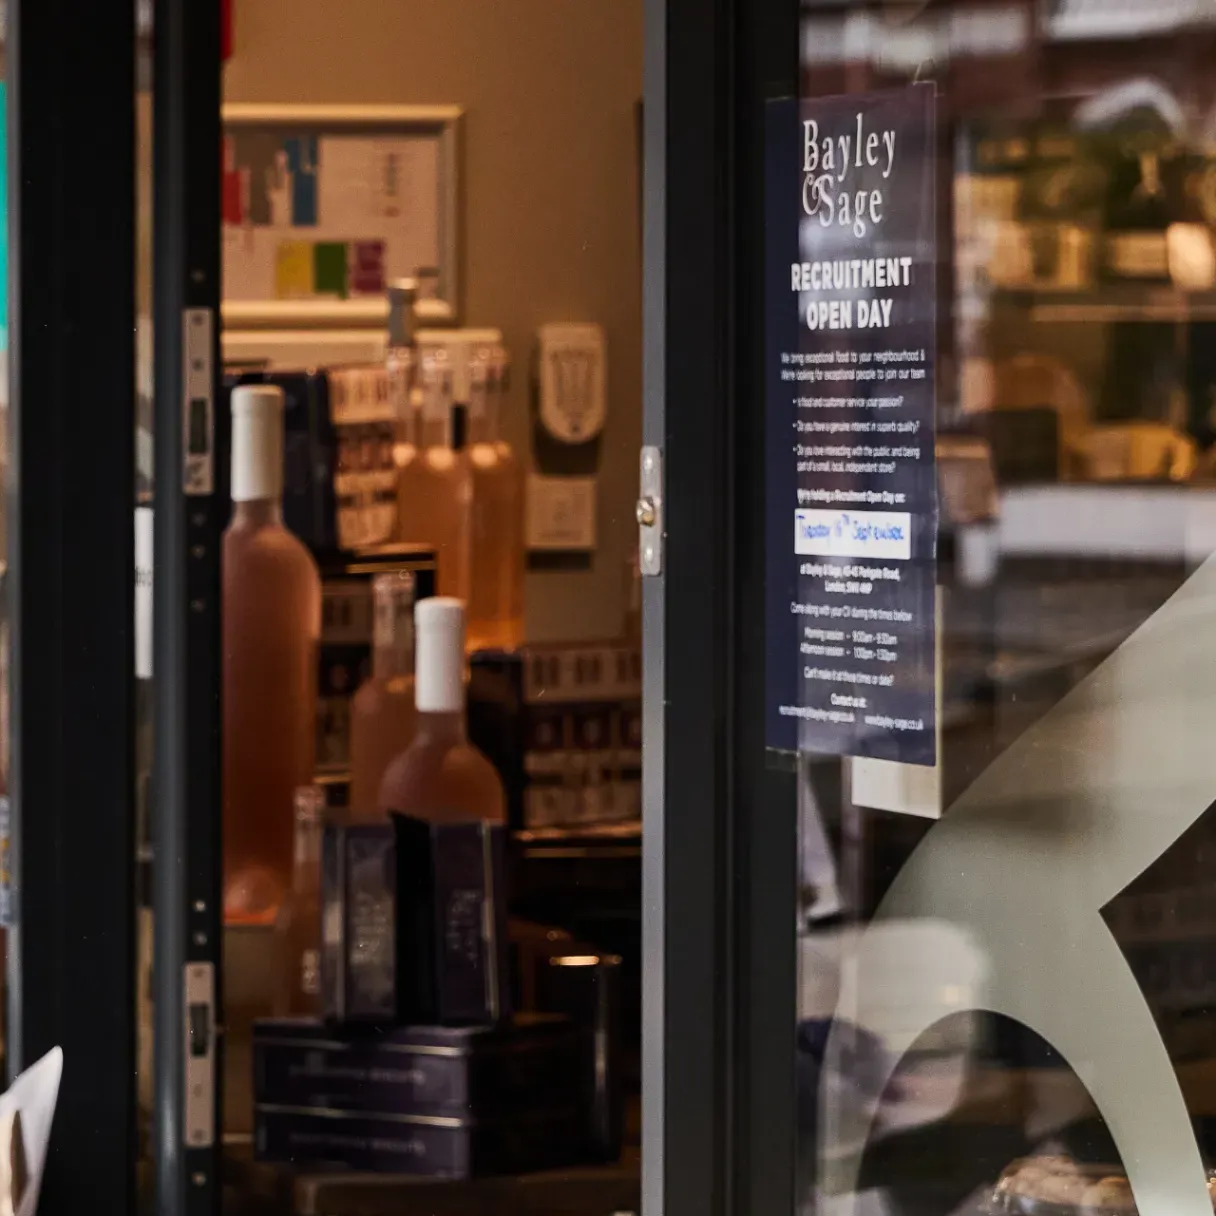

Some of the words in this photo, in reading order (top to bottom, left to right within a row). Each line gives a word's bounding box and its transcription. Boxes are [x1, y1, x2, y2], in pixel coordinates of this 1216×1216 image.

[802, 112, 896, 184] Bayley
[791, 257, 912, 292] RECRUITMENT
[806, 300, 852, 331] OPEN
[857, 299, 893, 329] DAY
